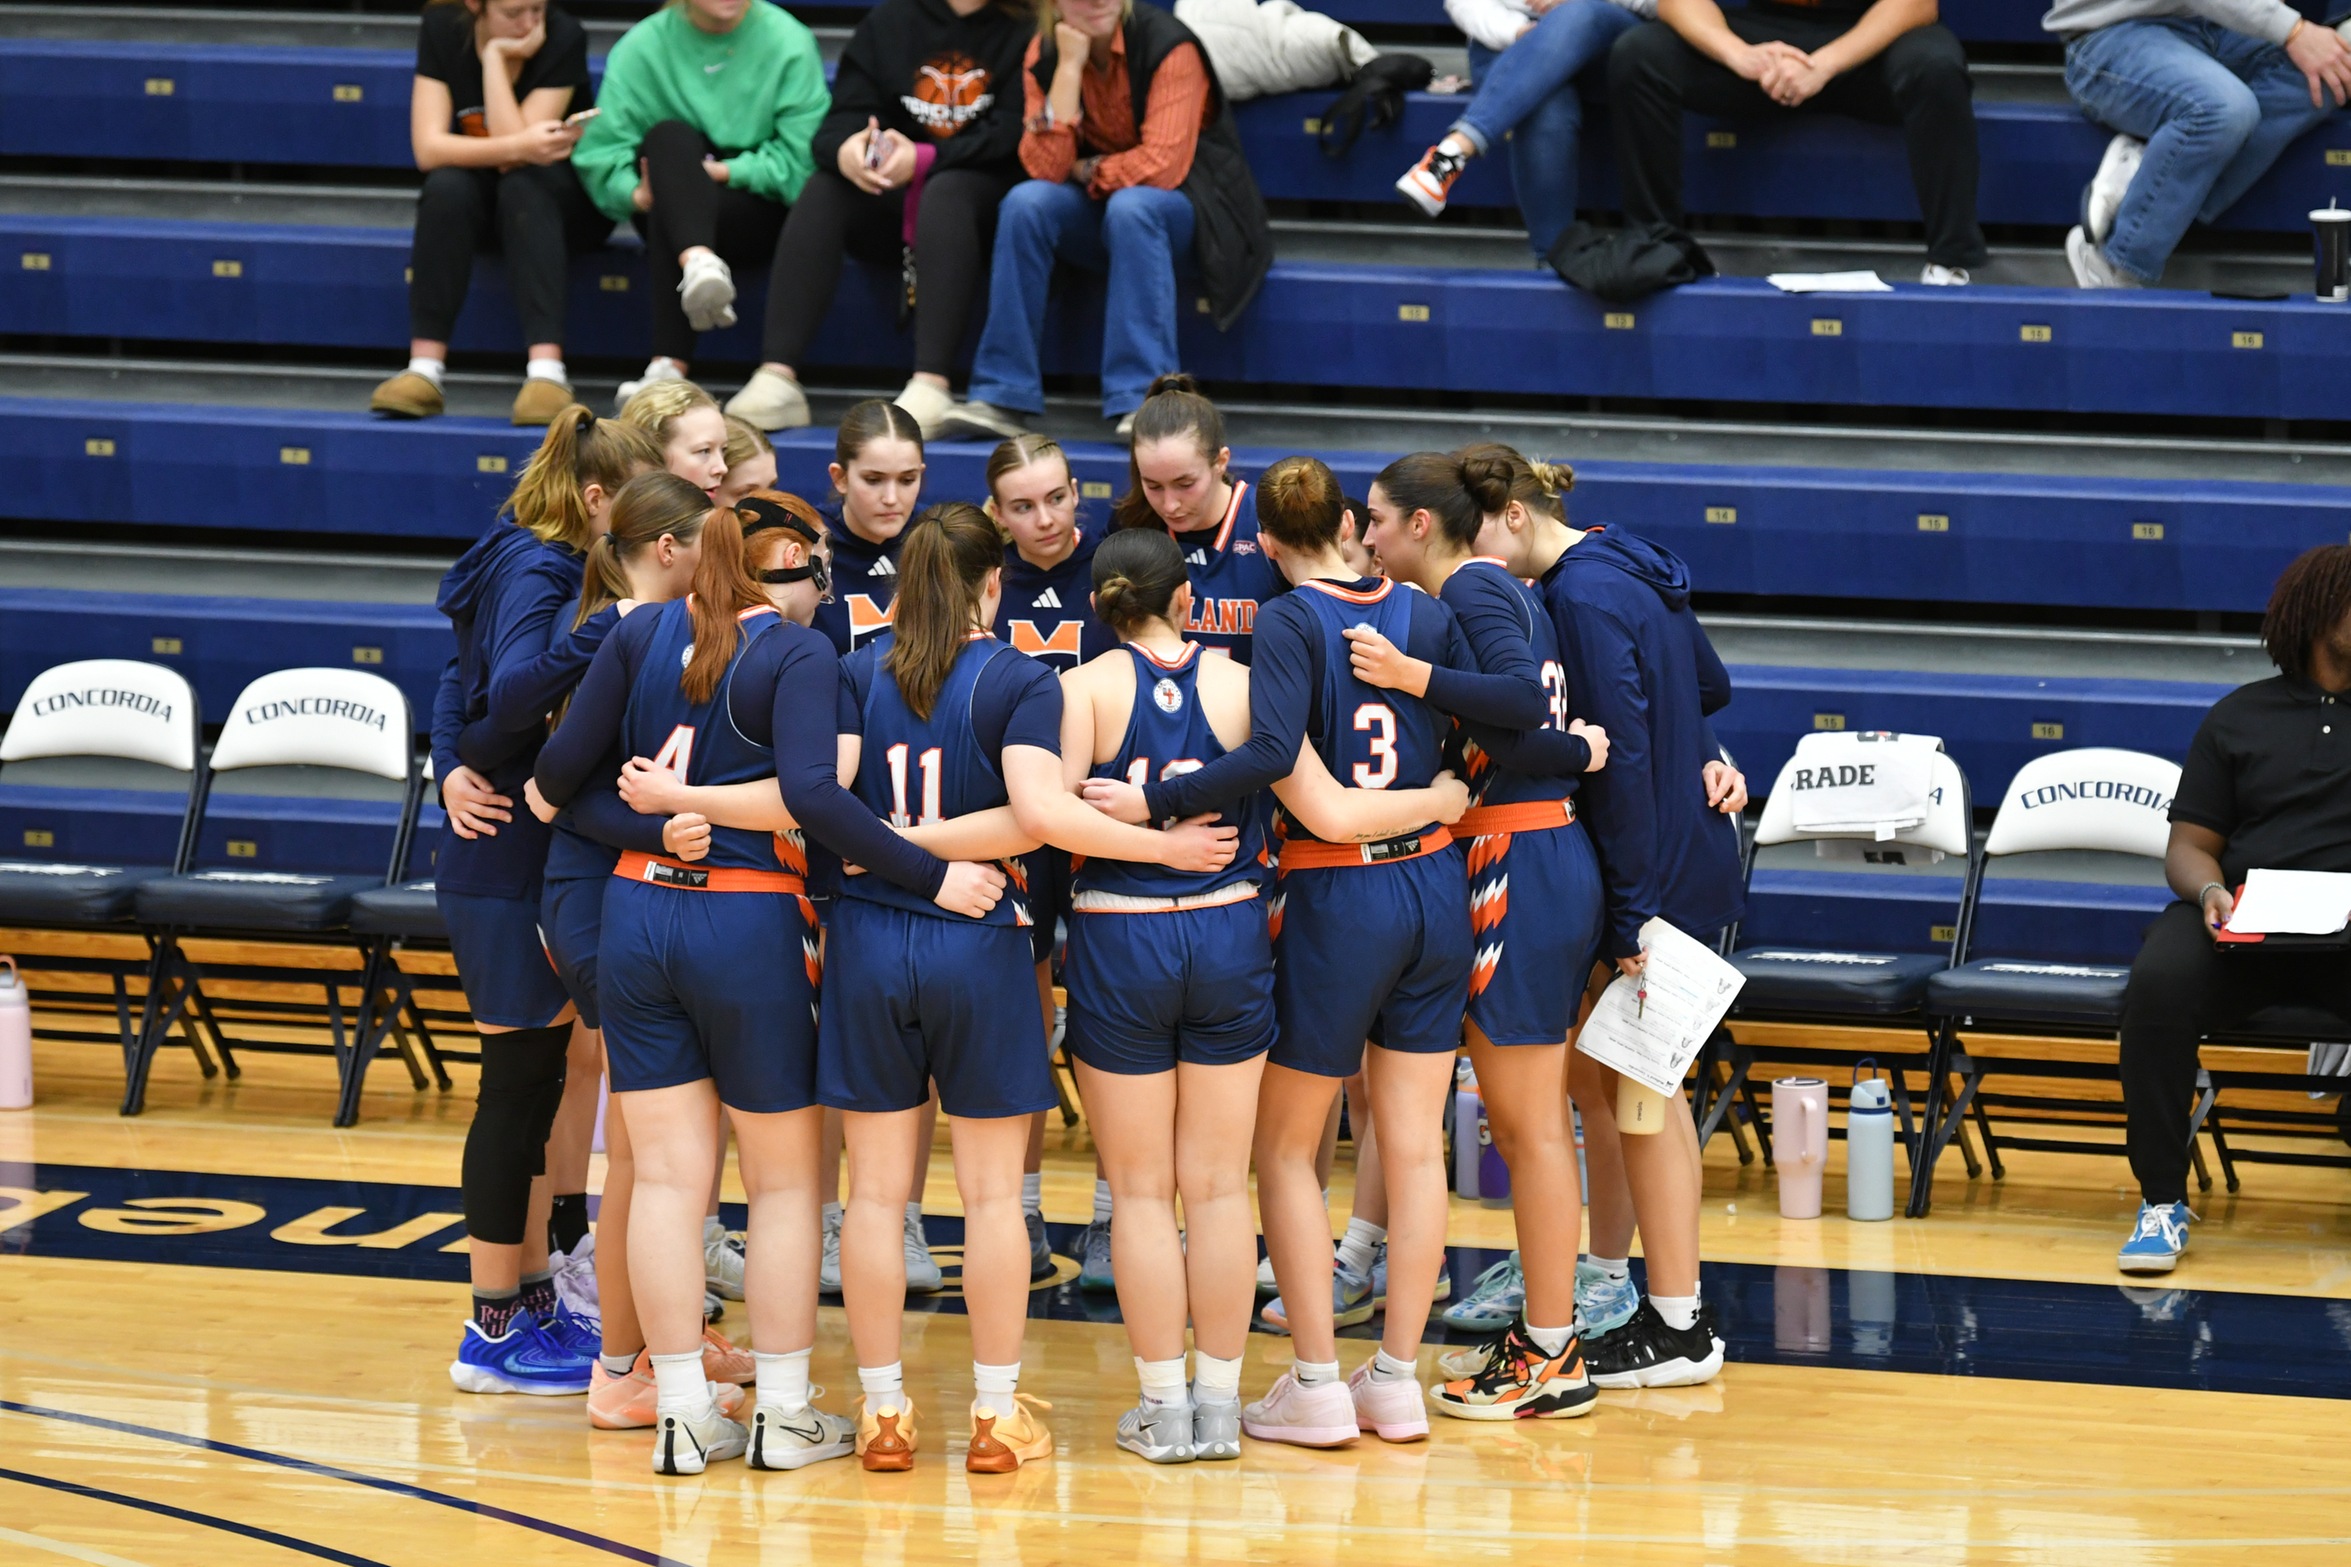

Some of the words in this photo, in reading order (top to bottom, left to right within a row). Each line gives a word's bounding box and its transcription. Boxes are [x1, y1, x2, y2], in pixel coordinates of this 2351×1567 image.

[33, 689, 173, 723] CONCORDIA
[246, 697, 387, 732] CONCORDIA
[1352, 703, 1398, 790] 3
[886, 742, 946, 828] 11
